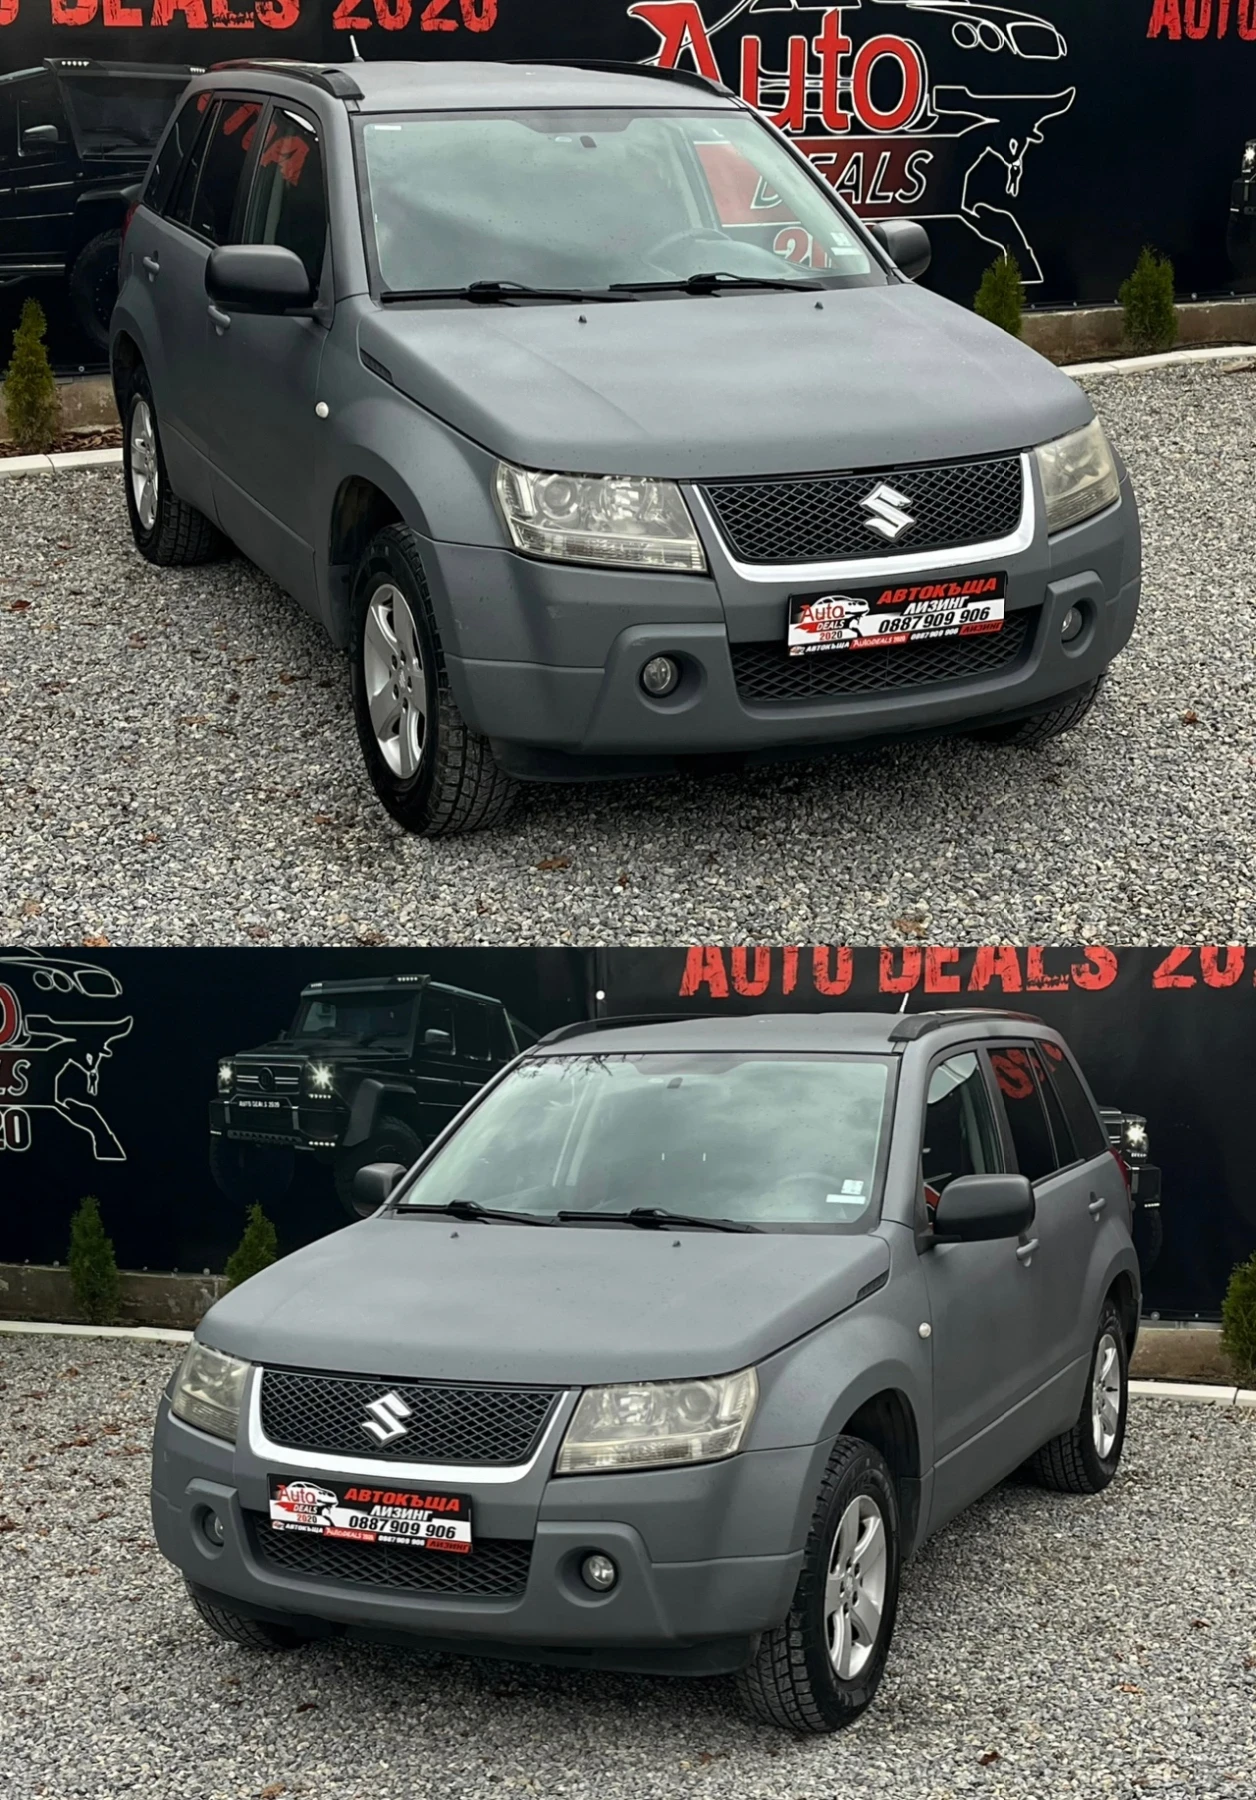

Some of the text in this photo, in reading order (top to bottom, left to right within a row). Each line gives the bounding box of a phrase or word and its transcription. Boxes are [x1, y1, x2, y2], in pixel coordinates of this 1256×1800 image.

[876, 577, 997, 605] АВТОКЪЩА
[800, 603, 845, 623] Auto
[902, 596, 970, 615] ЛИЗИНГ
[959, 606, 991, 623] 906
[816, 620, 845, 631] DEALS
[820, 630, 843, 641] 2020
[679, 946, 853, 997] AUTO
[879, 946, 1118, 993] DEALS
[276, 1484, 317, 1504] Auto
[343, 1488, 460, 1511] АВТОКЪЩА
[293, 1504, 317, 1514] DEALS
[370, 1505, 433, 1521] ЛИЗИНГ
[297, 1513, 317, 1524] 2020
[425, 1523, 457, 1539] 906
